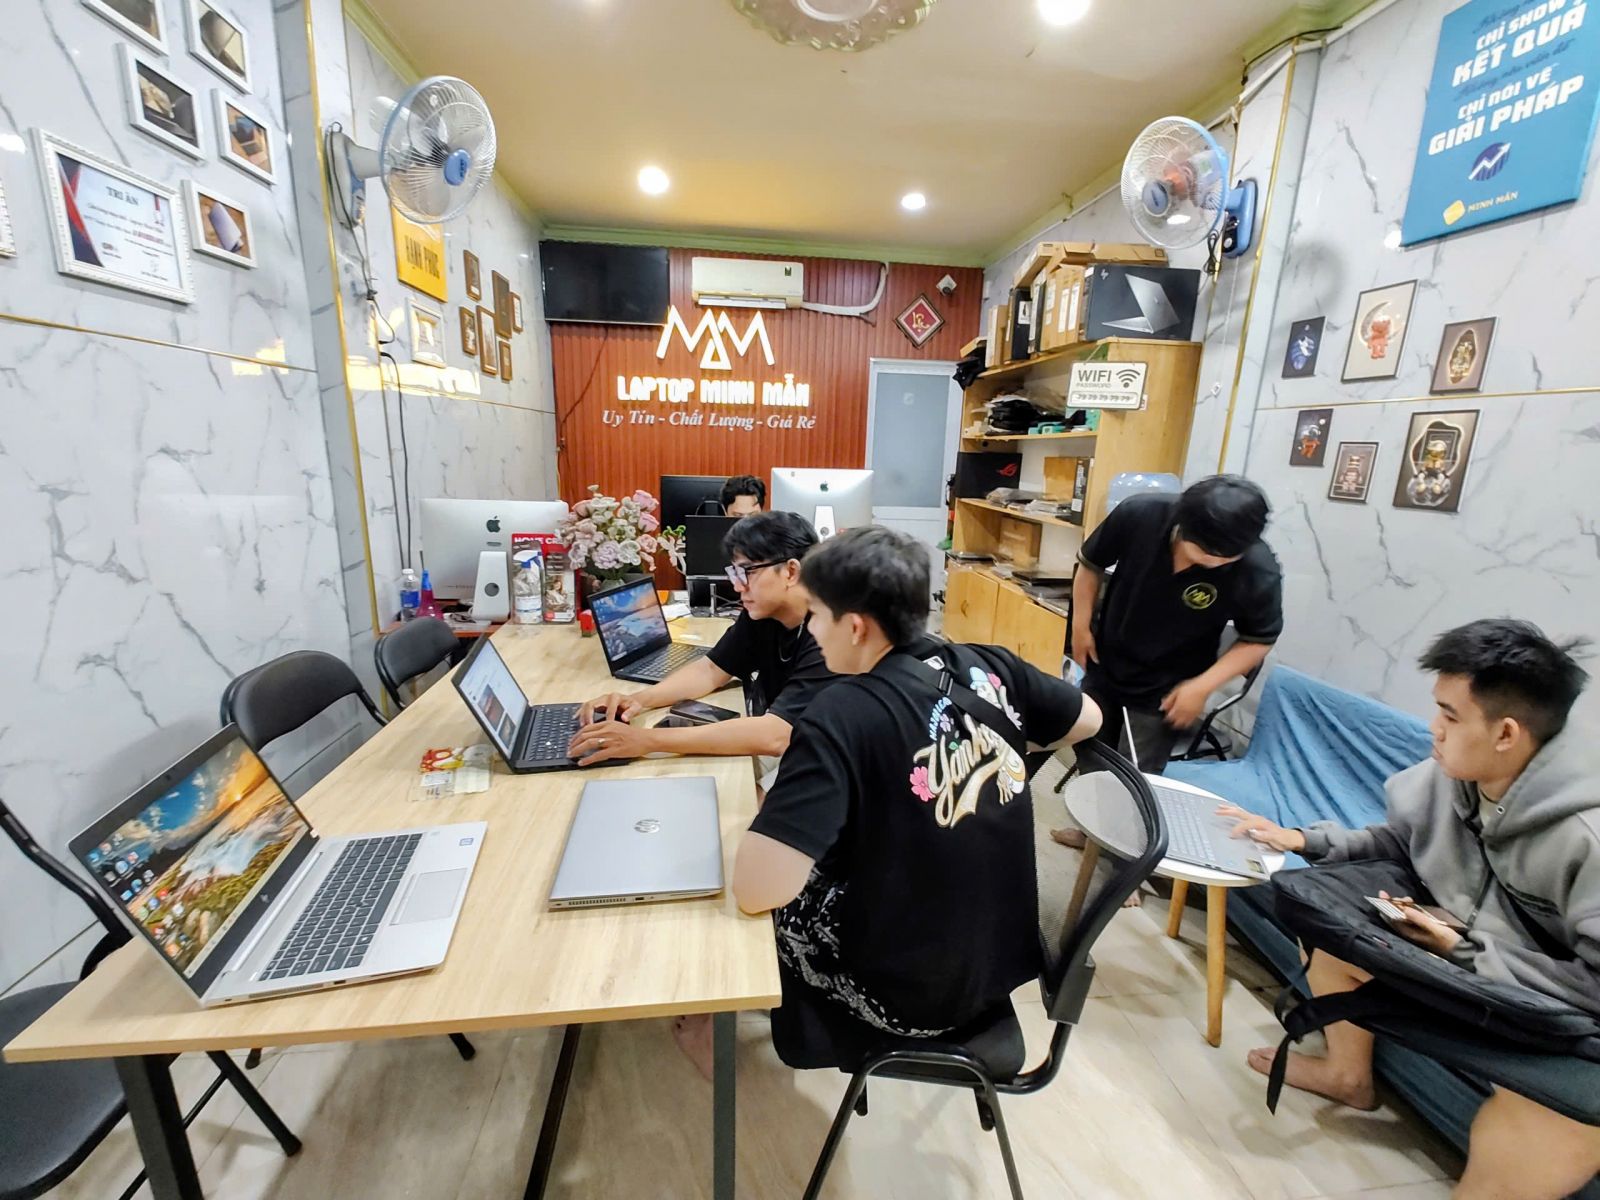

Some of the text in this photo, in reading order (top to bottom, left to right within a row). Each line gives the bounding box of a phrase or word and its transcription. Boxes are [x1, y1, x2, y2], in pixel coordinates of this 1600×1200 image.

[1452, 41, 1507, 87] KẾT
[1428, 75, 1584, 155] GIẢI PHÁP
[617, 375, 695, 403] LAPTOP
[700, 379, 755, 405] MINH
[1078, 370, 1112, 382] WIFI
[602, 409, 624, 427] Uy
[629, 409, 654, 426] Tín
[668, 408, 703, 427] Chất
[708, 412, 754, 432] Lượng
[767, 413, 793, 429] Giá
